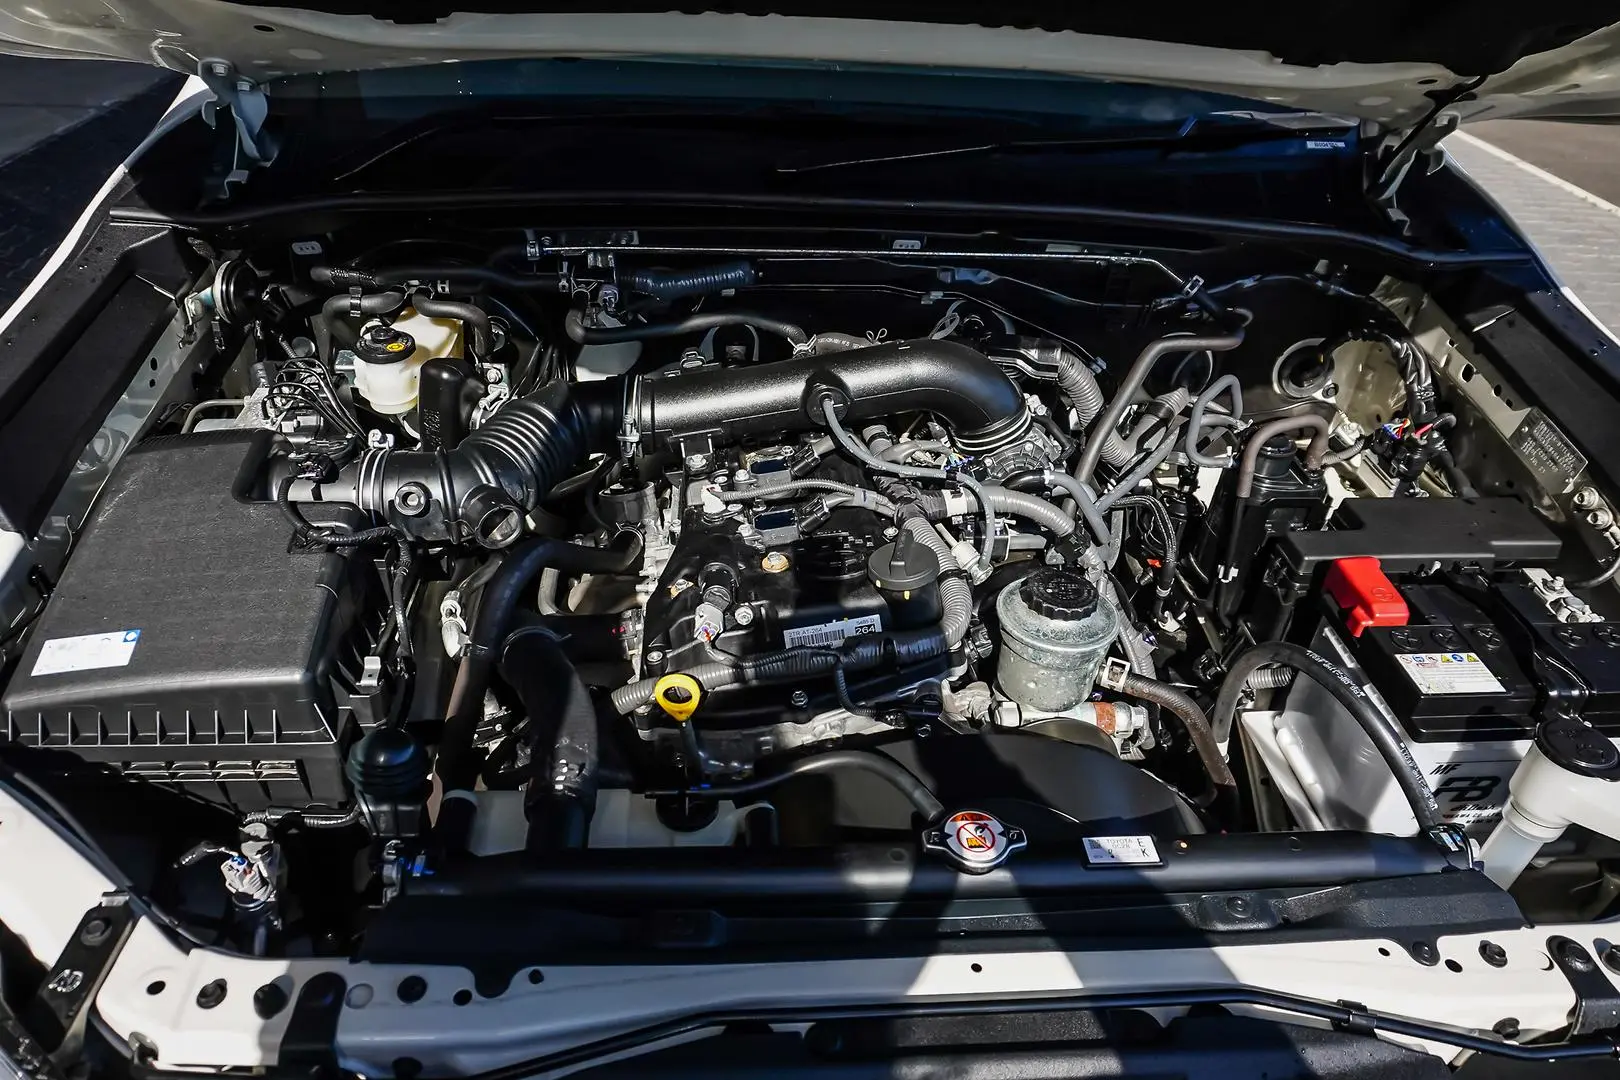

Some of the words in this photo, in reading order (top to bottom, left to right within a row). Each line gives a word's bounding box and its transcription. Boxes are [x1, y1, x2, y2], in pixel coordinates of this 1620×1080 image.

[855, 625, 875, 635] 264
[1429, 763, 1463, 775] MF
[1137, 838, 1146, 848] E
[1141, 848, 1149, 858] K
